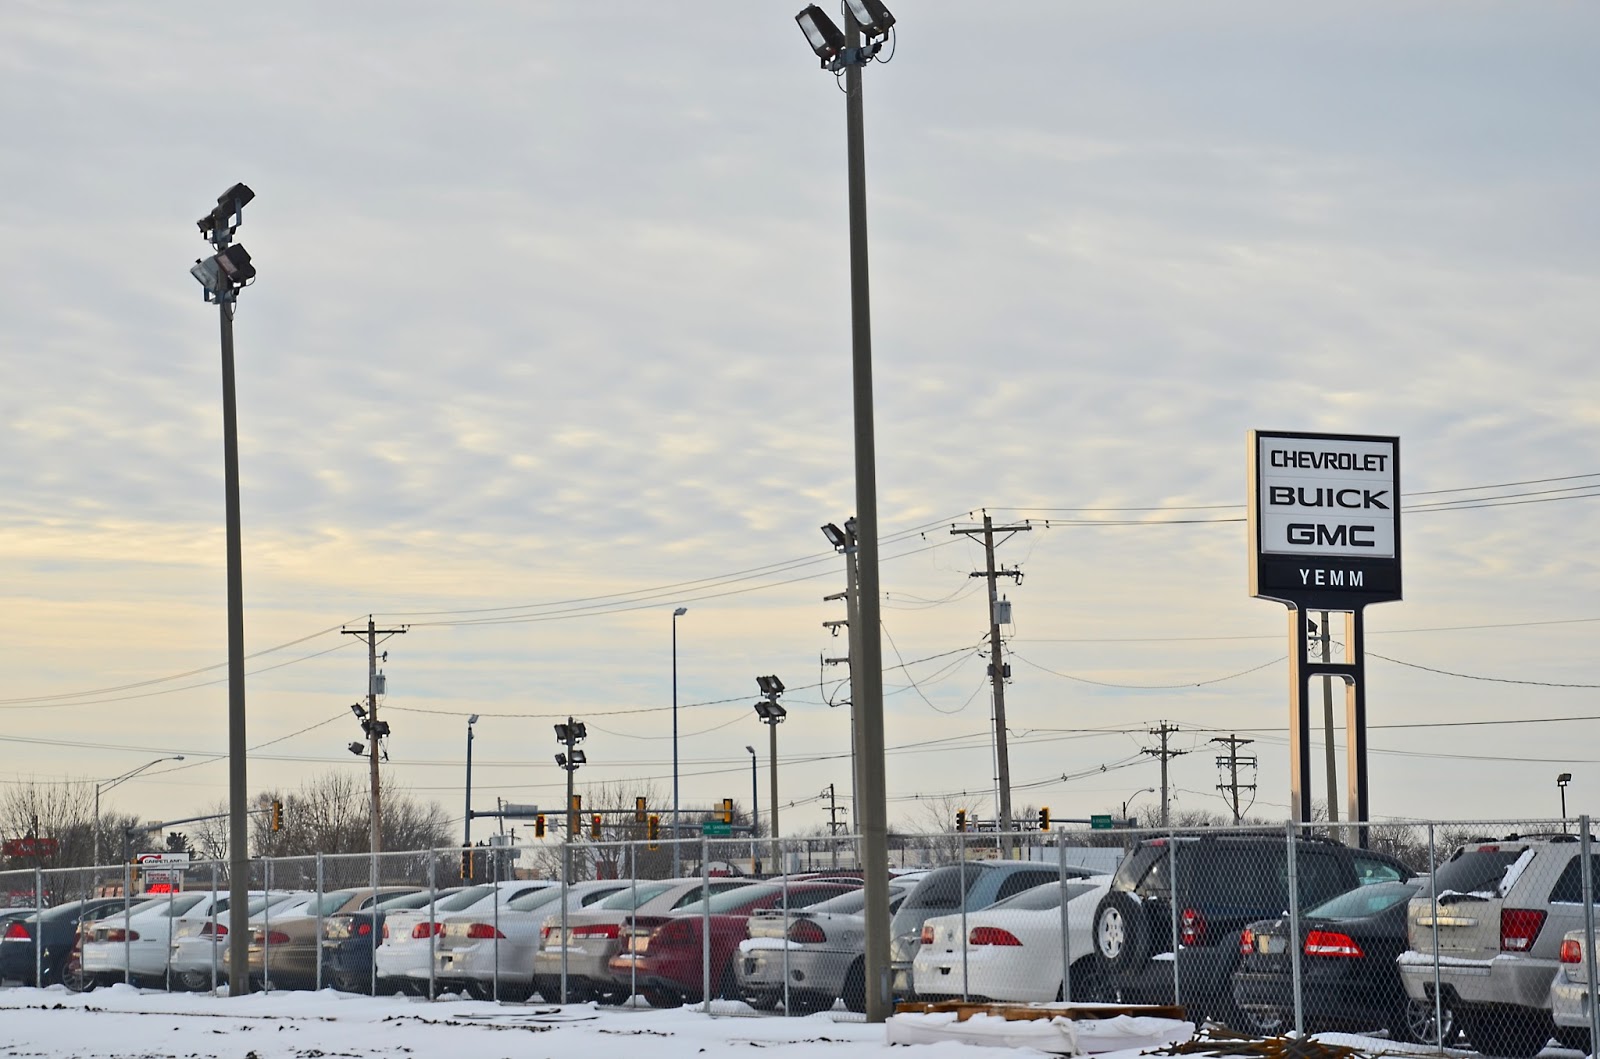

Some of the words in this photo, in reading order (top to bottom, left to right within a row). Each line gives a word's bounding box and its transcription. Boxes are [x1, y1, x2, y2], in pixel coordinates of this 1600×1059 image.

[1270, 449, 1388, 472] CHEVROLET
[1269, 485, 1390, 510] BUICK
[1286, 523, 1375, 547] GMC
[1299, 568, 1364, 587] YEMM
